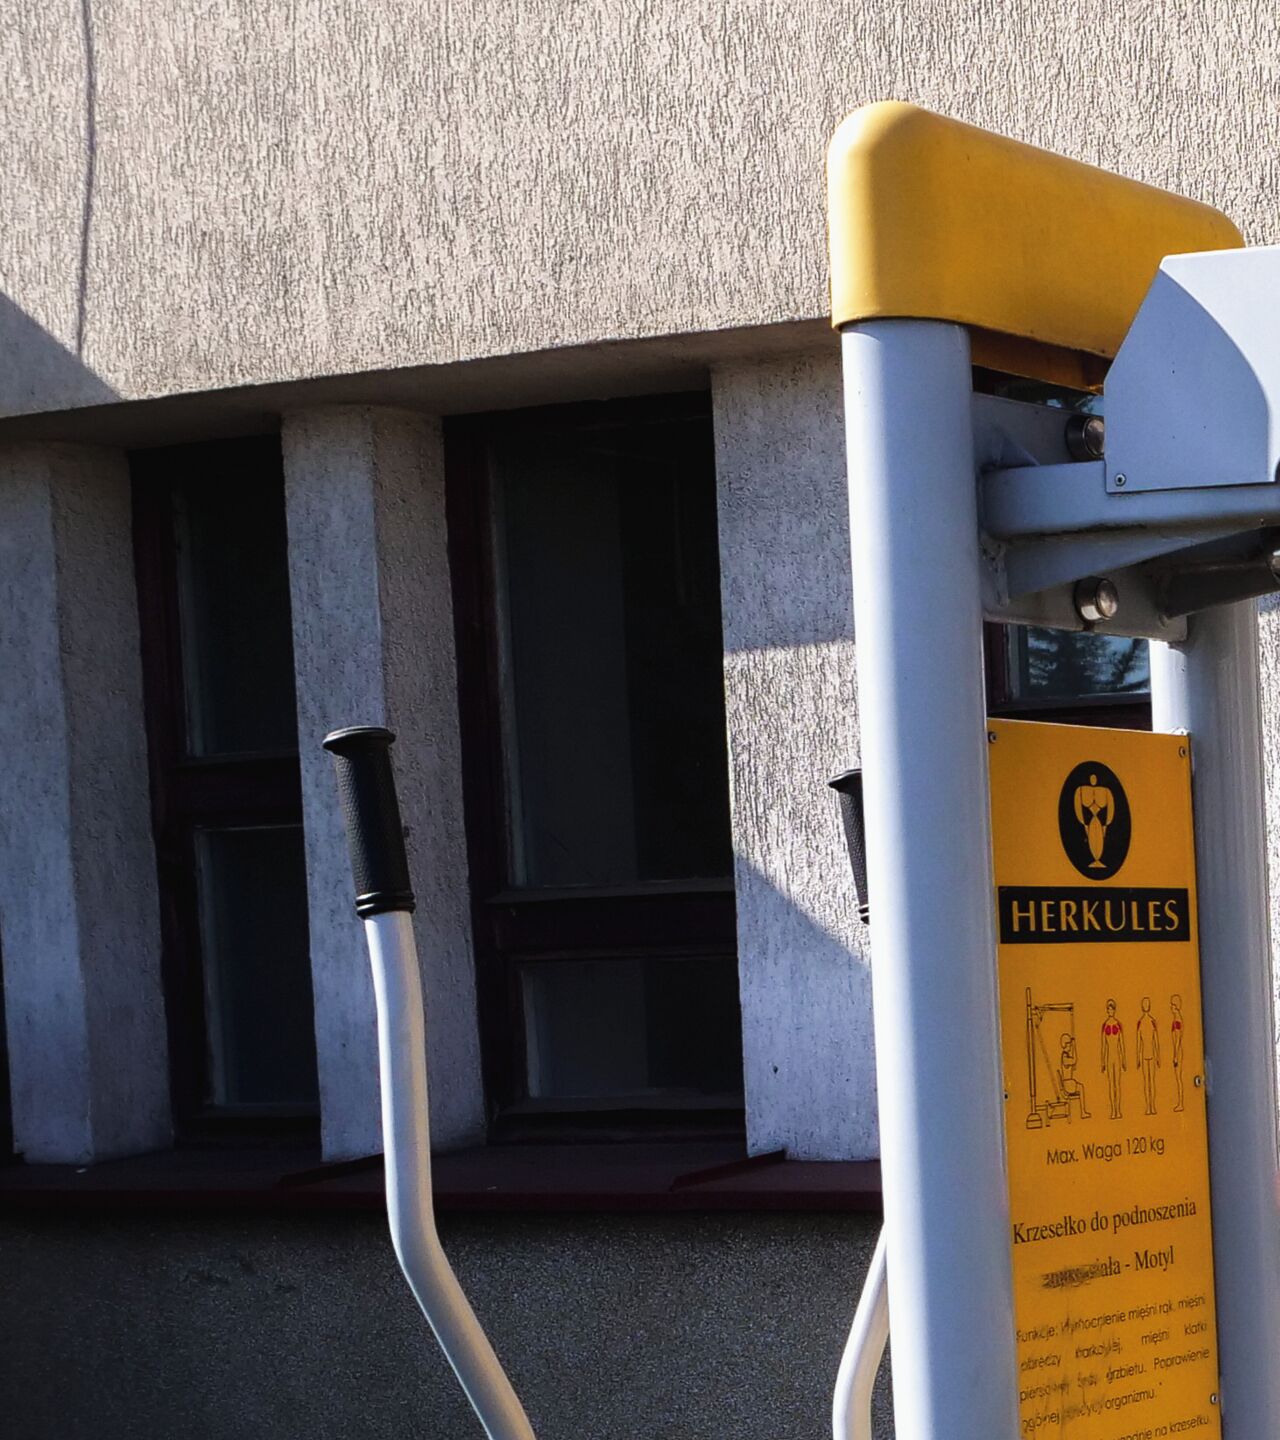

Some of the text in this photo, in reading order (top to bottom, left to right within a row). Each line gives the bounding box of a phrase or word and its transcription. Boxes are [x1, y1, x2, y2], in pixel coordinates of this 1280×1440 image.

[1012, 900, 1179, 932] HERKULES
[1047, 1137, 1165, 1165] Max. Waga 120 kg
[1013, 1197, 1196, 1244] Krzesełko do podnoszenia
[1134, 1245, 1174, 1272] Motyl
[1128, 1304, 1157, 1320] mięśni
[1141, 1328, 1169, 1345] mięśni
[1184, 1321, 1207, 1336] klatki
[1153, 1349, 1210, 1371] Poprawienie
[1155, 1425, 1167, 1438] na
